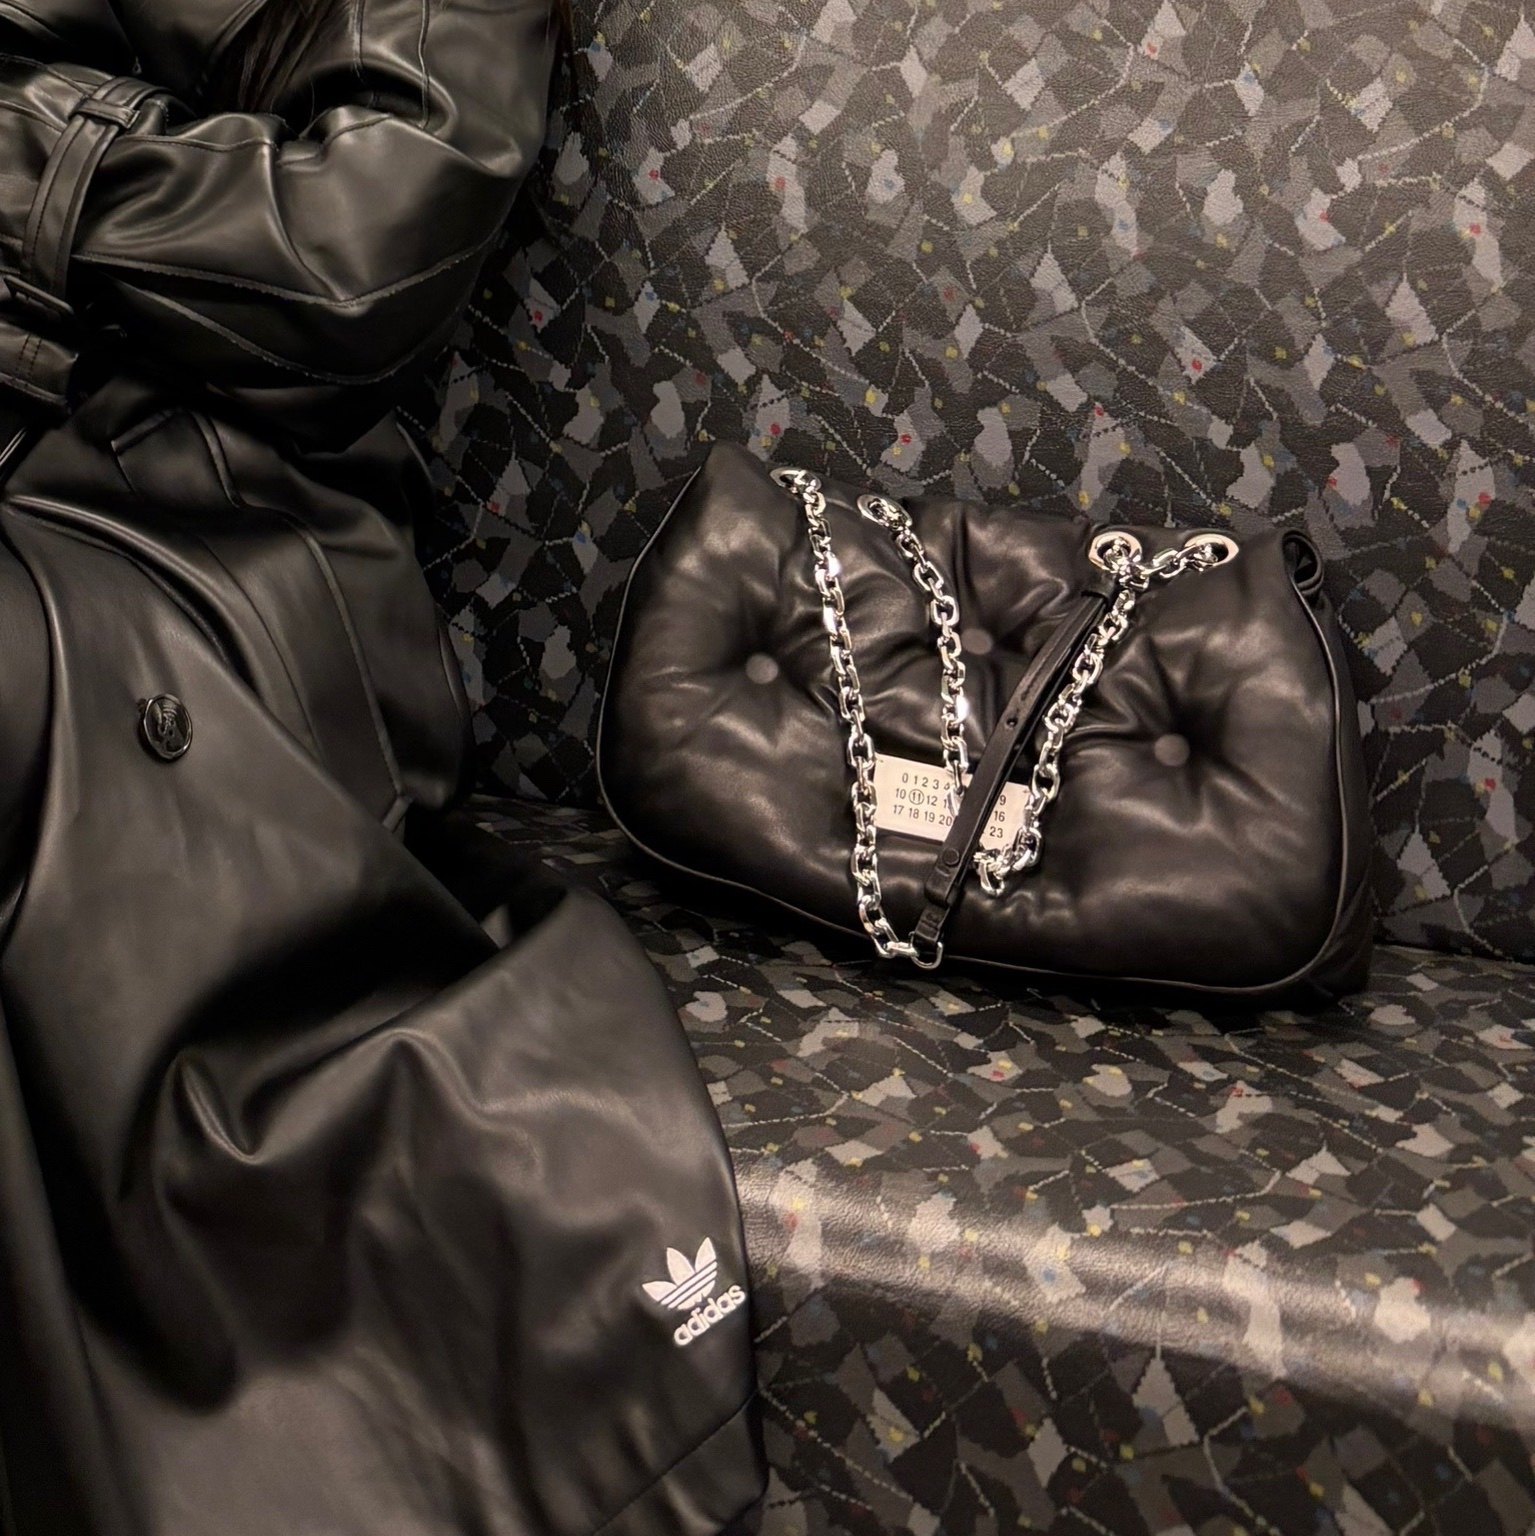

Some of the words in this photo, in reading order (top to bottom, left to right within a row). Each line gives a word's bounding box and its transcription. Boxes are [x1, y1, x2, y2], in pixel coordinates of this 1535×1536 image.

[895, 788, 907, 799] 10
[911, 790, 922, 804] 11
[926, 795, 938, 806] 12
[994, 810, 1006, 822] 16
[902, 773, 908, 784] 0
[914, 775, 918, 786] 1
[922, 777, 929, 788] 2
[932, 779, 940, 790] 3
[999, 794, 1007, 806] 9
[893, 804, 905, 815] 17
[909, 807, 920, 819] 18
[924, 811, 936, 823] 19
[938, 814, 953, 827] 20
[989, 826, 1004, 839] 23
[674, 1285, 747, 1346] adidas
